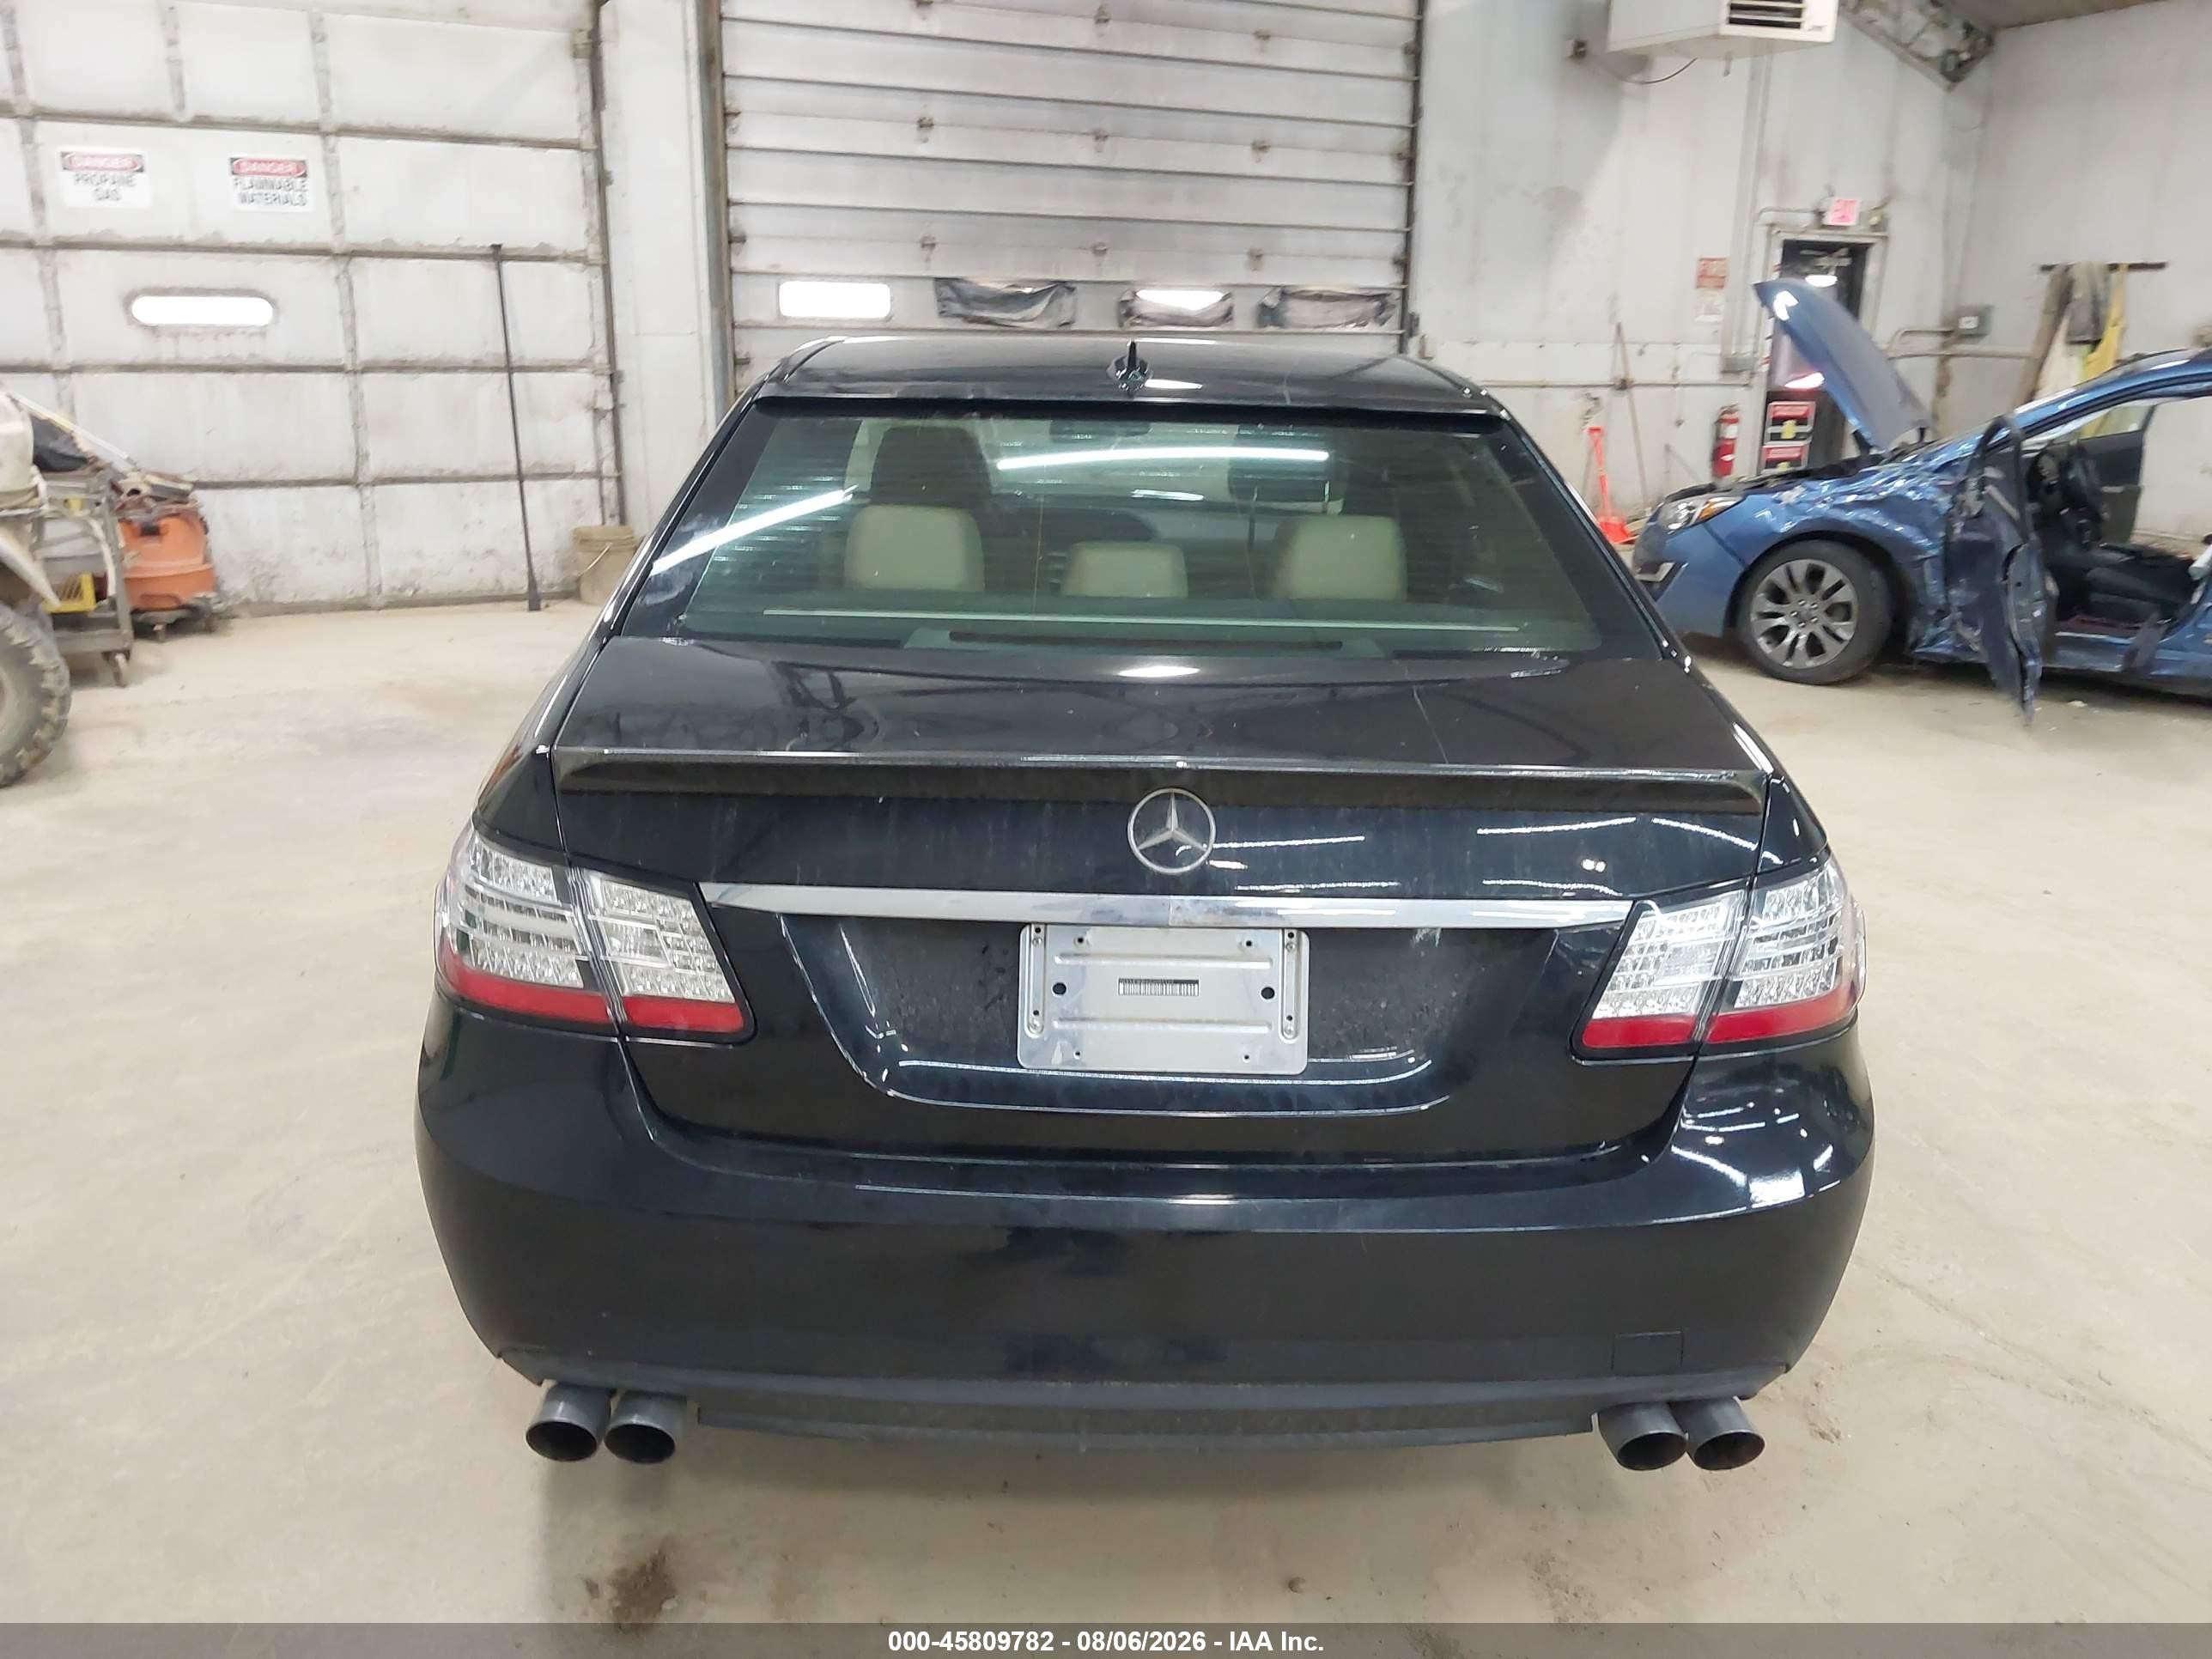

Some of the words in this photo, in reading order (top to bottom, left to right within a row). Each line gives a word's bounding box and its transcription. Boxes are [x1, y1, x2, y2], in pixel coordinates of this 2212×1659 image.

[74, 172, 137, 187] PROPANE
[234, 177, 310, 192] FLAMMABLE
[238, 191, 307, 207] MATERIALS
